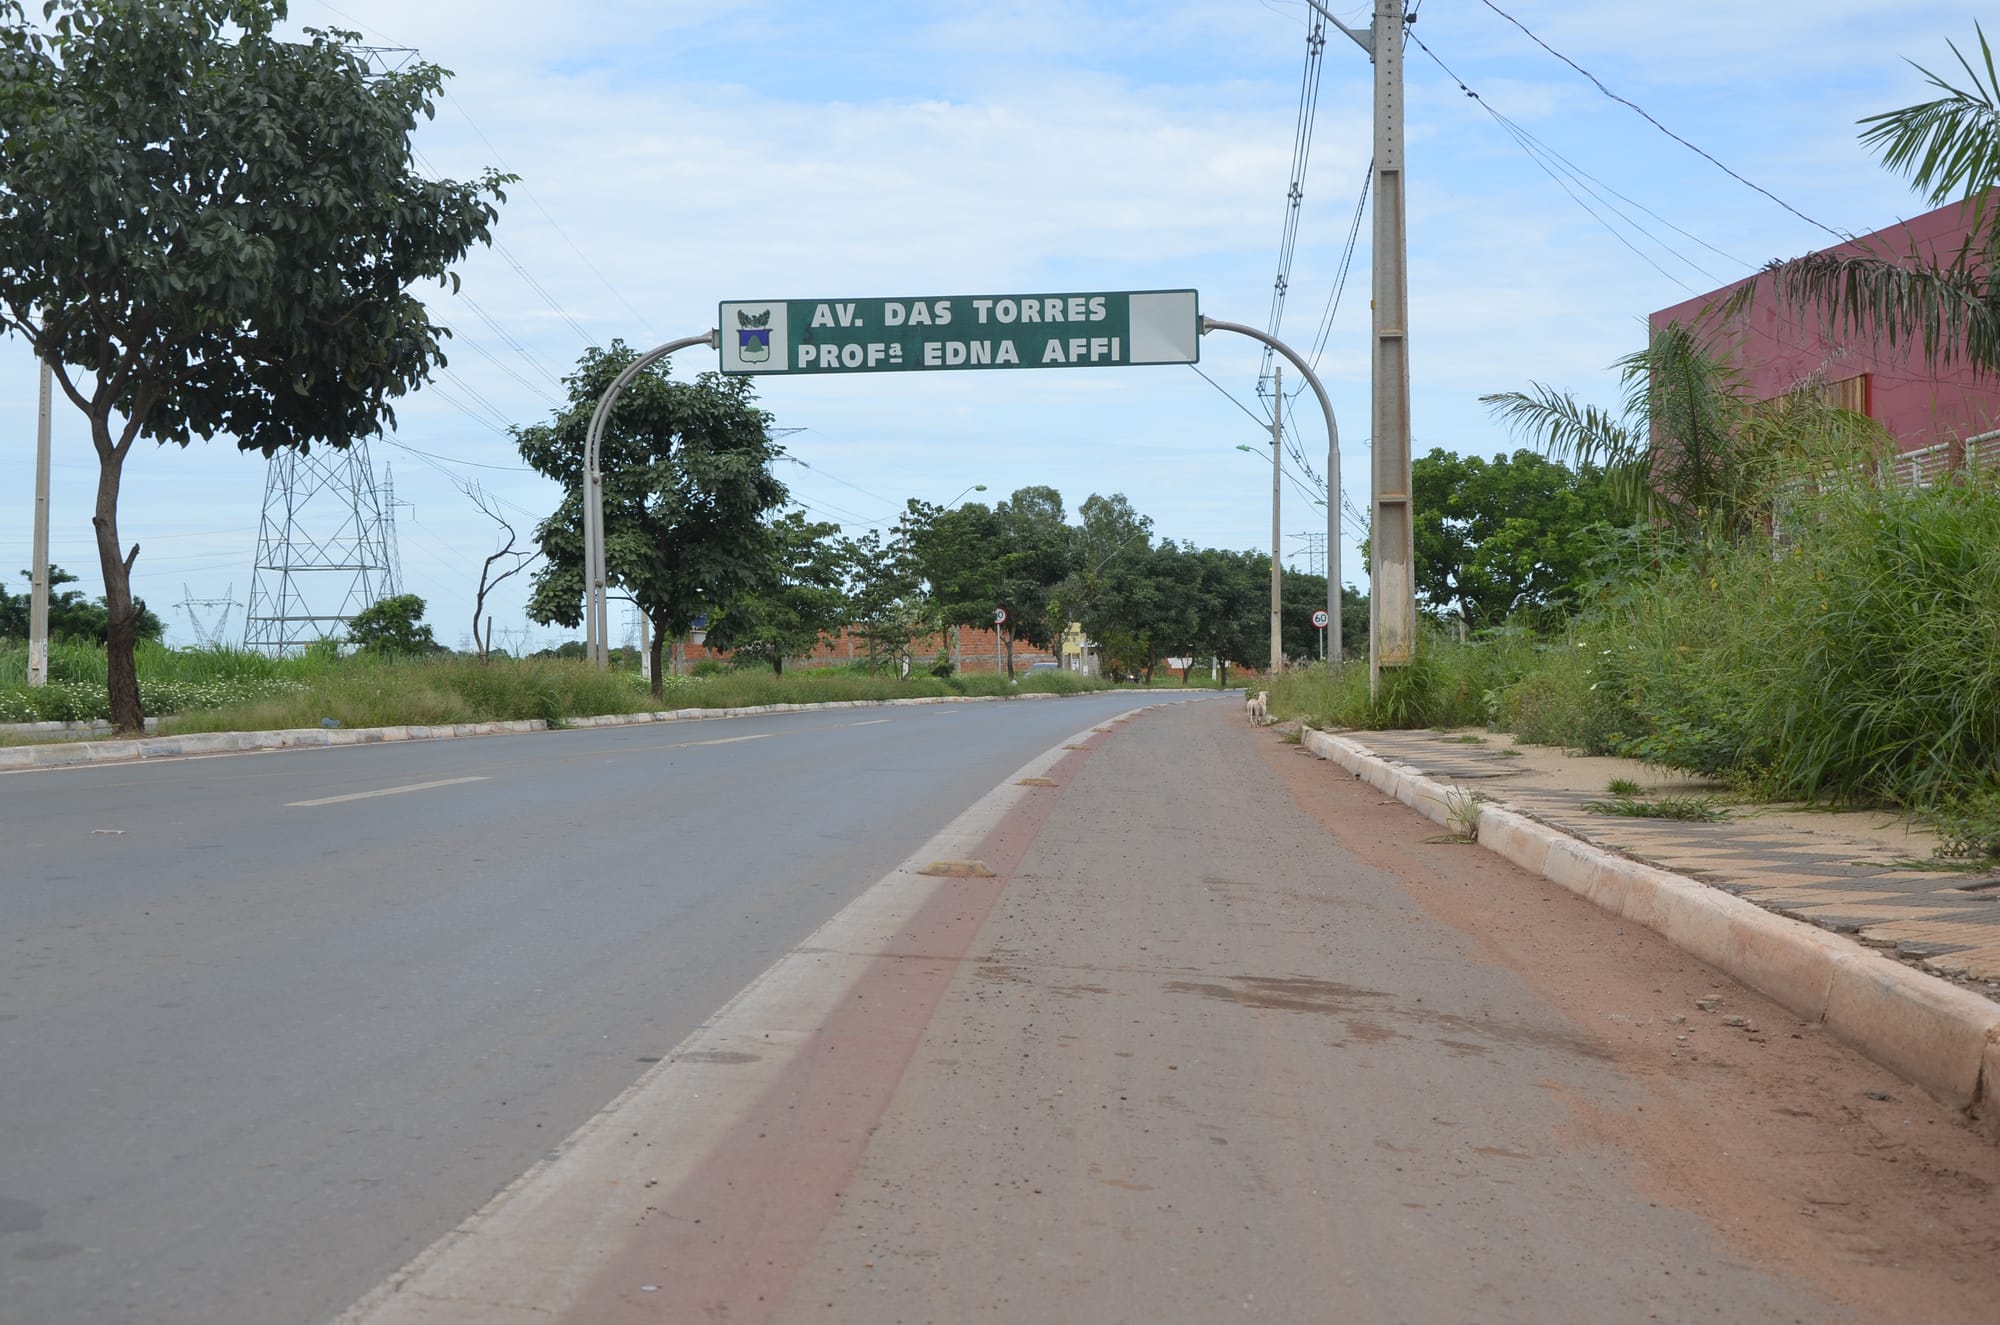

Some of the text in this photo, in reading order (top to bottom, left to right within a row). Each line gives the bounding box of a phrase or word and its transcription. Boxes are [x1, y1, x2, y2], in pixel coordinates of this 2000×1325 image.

[811, 297, 1106, 327] AV. DAS TORRES
[925, 341, 1019, 365] EDNA
[1042, 338, 1119, 362] AFFI
[1314, 613, 1327, 623] 60
